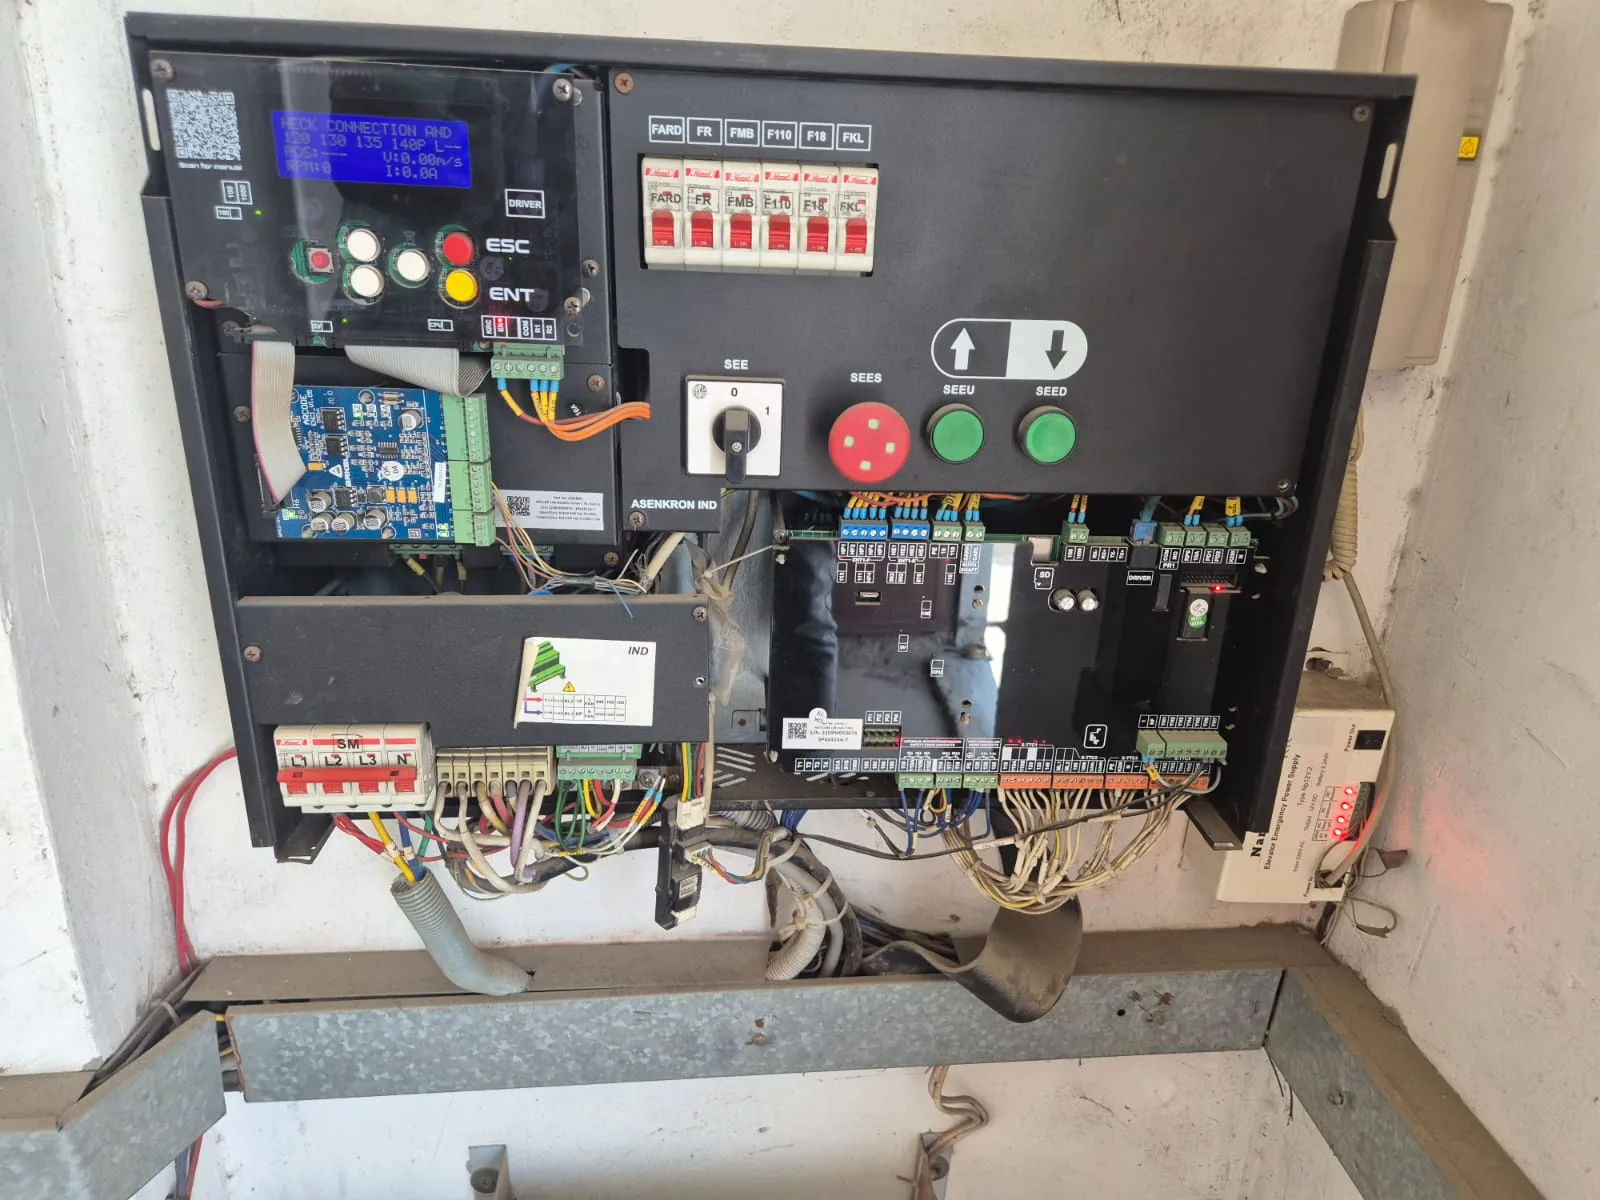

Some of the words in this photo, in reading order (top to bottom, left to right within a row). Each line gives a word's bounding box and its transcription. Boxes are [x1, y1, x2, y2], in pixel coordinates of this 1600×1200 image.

[281, 117, 317, 130] HECK
[326, 120, 416, 137] CONNECTION
[425, 126, 452, 138] AND
[651, 124, 682, 136] FARD
[696, 126, 712, 137] FR
[730, 128, 754, 138] FMB
[768, 129, 792, 140] F110
[807, 131, 826, 142] F18
[842, 132, 864, 144] FKL
[321, 134, 346, 147] 130
[357, 136, 382, 148] 135
[508, 199, 542, 208] DRIVER
[651, 192, 682, 204] FARD
[695, 194, 712, 206] FR
[728, 196, 754, 208] FMB
[764, 198, 791, 210] F110
[840, 202, 860, 212] FKL
[486, 238, 530, 254] ESC
[489, 286, 535, 302] ENT
[724, 359, 749, 370] SEE
[850, 372, 882, 384] SEES
[731, 388, 738, 397] 0
[943, 385, 975, 396] SEEU
[1036, 386, 1068, 396] SEED
[300, 394, 311, 426] ARCODE
[764, 406, 770, 416] 1
[631, 499, 695, 510] ASENKRON
[698, 500, 718, 510] IND
[628, 646, 648, 656] IND
[338, 738, 360, 749] SM
[291, 756, 307, 767] L1
[325, 756, 342, 766] L2
[360, 754, 377, 765] L3
[398, 754, 407, 765] N
[1264, 842, 1277, 870] Elevator
[1271, 804, 1288, 841] Emergency
[1282, 780, 1292, 802] Power
[1288, 754, 1301, 778] Supply
